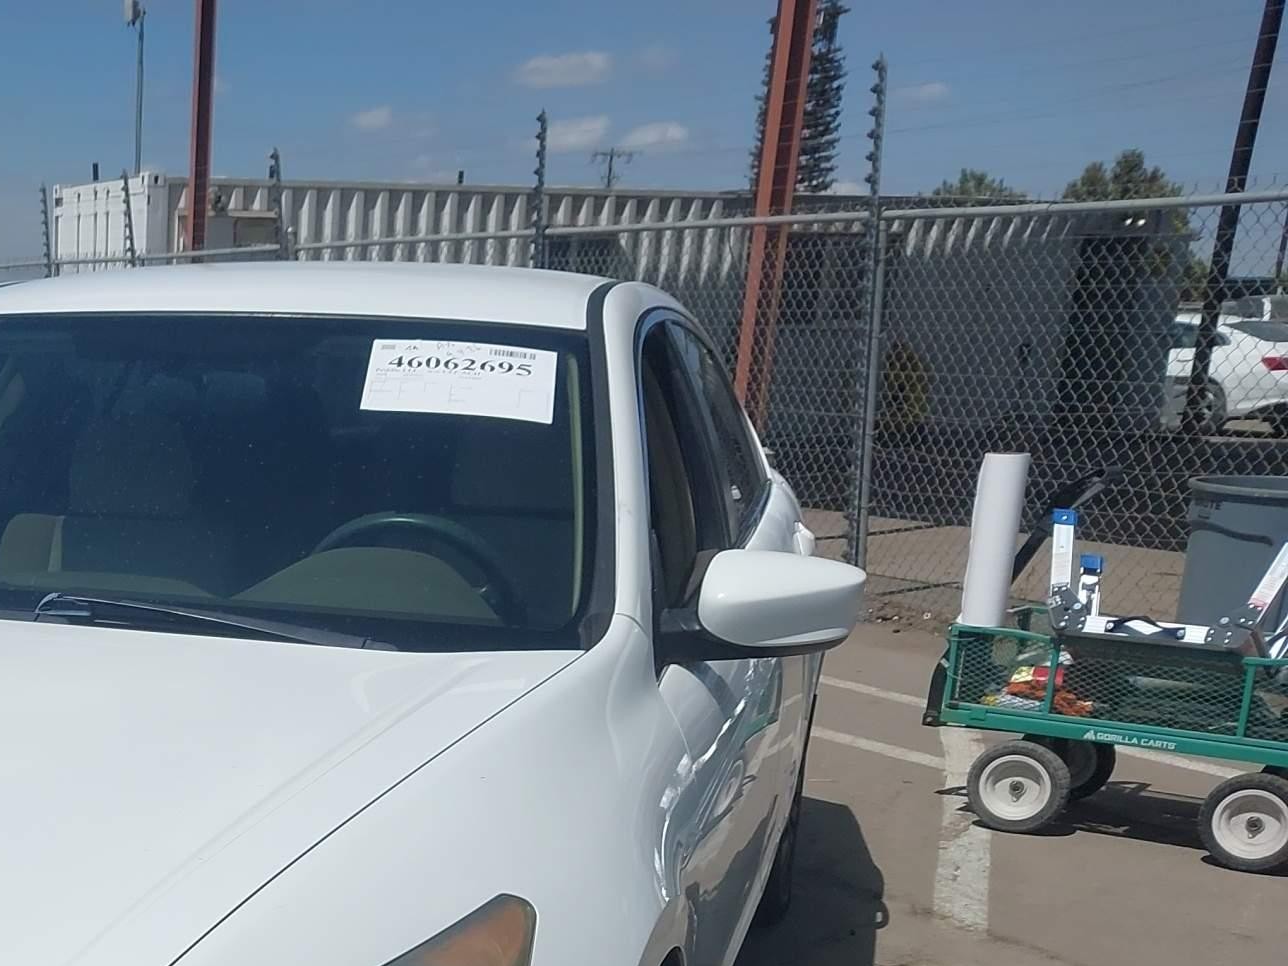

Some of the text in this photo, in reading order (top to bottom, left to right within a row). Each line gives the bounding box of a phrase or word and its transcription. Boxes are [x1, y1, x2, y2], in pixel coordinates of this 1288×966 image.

[388, 355, 532, 376] 46062695
[1096, 732, 1177, 750] GORILLA CARTS
